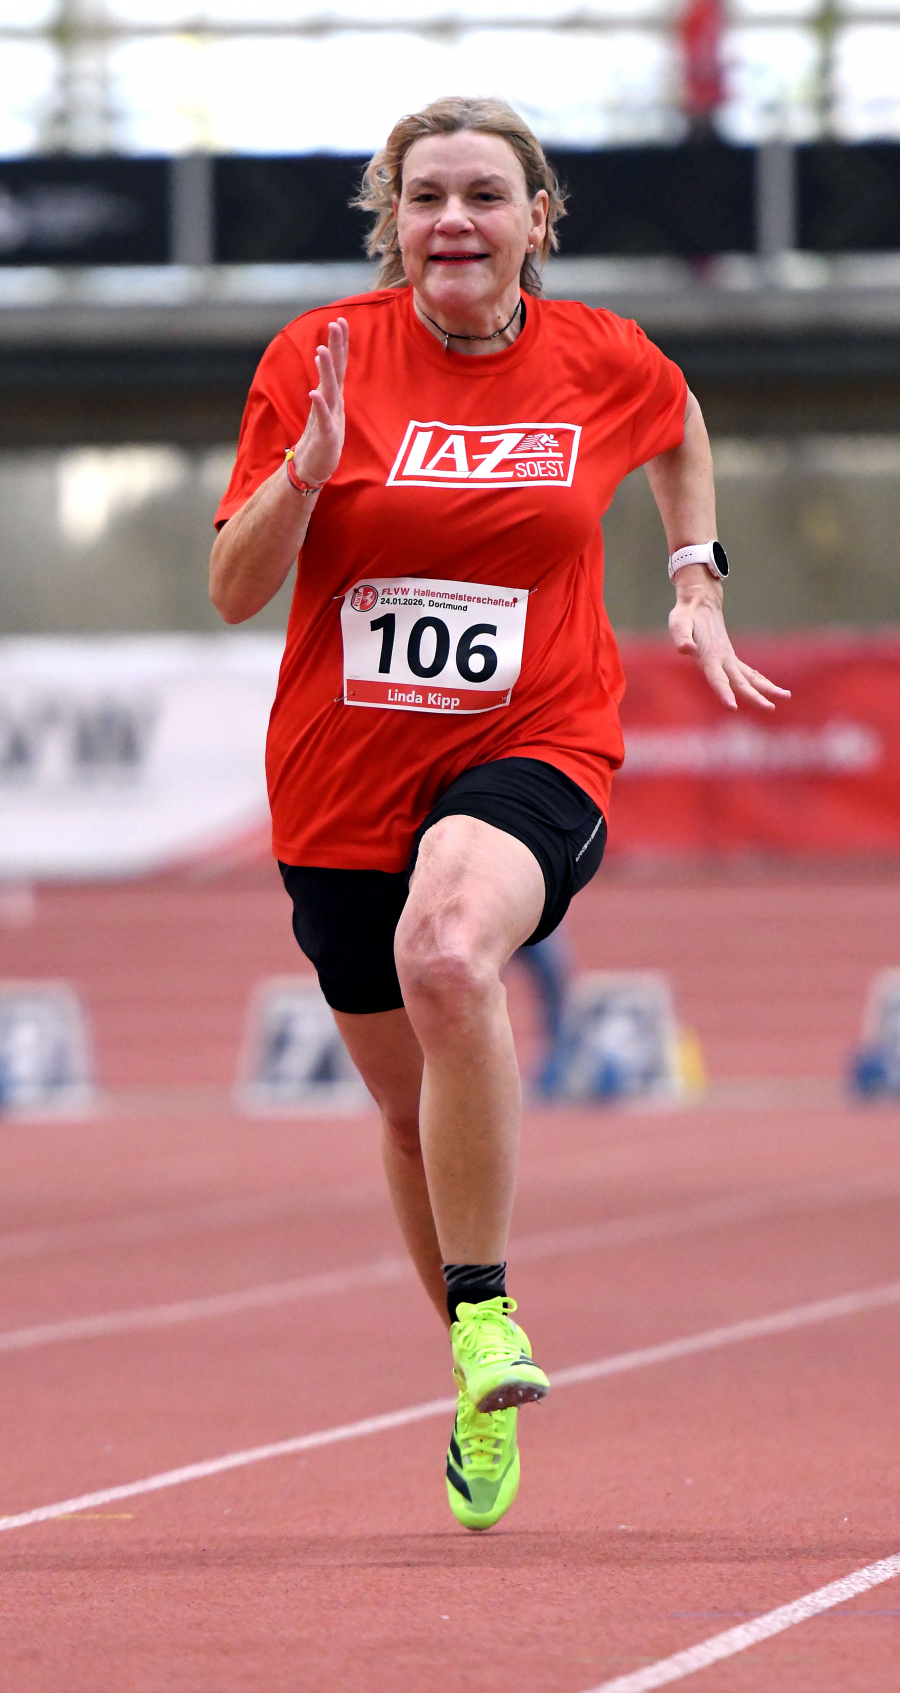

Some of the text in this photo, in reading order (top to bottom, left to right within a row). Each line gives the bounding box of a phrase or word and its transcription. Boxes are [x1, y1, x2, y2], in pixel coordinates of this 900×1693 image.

[402, 431, 525, 478] LAZ
[515, 461, 564, 478] SOEST
[380, 597, 468, 612] 24.01.2026, Dortmund
[381, 587, 516, 608] FLVW Hallenmeisterschaften
[370, 612, 498, 684] 106
[387, 689, 461, 710] Linda Kipp
